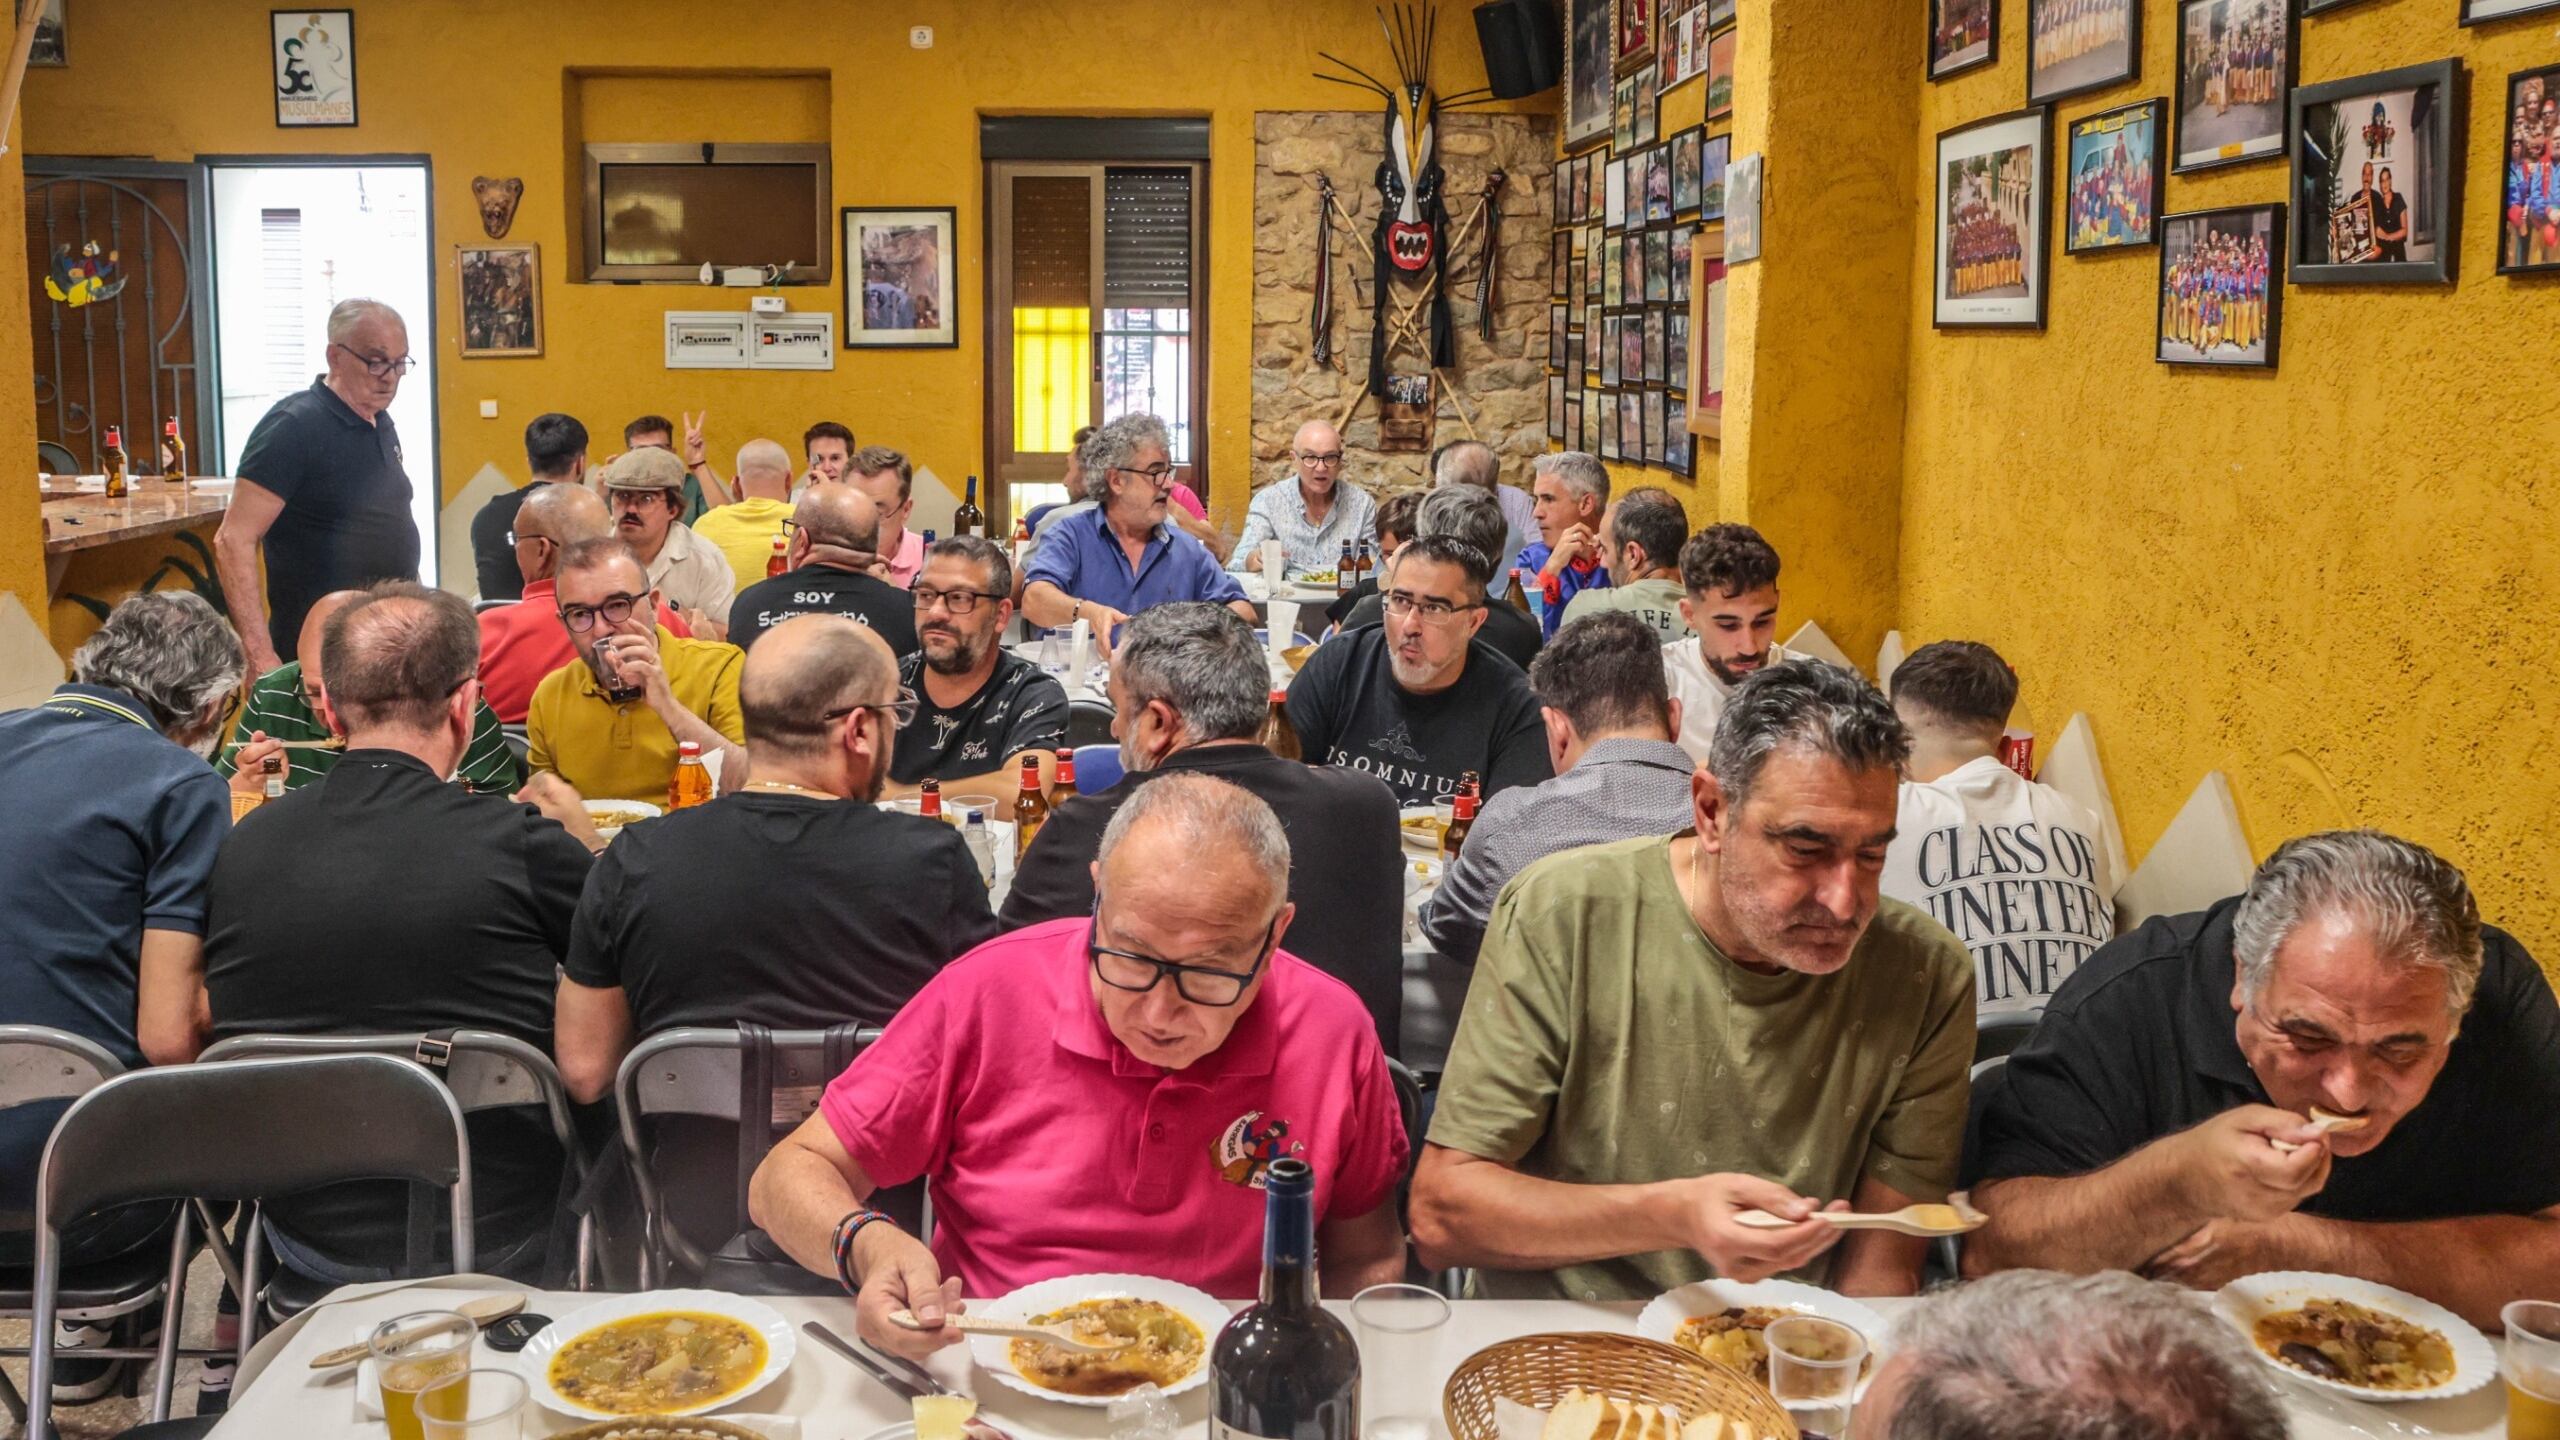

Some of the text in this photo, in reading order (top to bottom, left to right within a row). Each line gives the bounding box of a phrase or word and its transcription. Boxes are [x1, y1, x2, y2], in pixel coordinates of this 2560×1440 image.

[279, 102, 352, 116] MUSULMANES
[793, 591, 836, 604] SOY
[1917, 822, 2097, 888] CLASS OF
